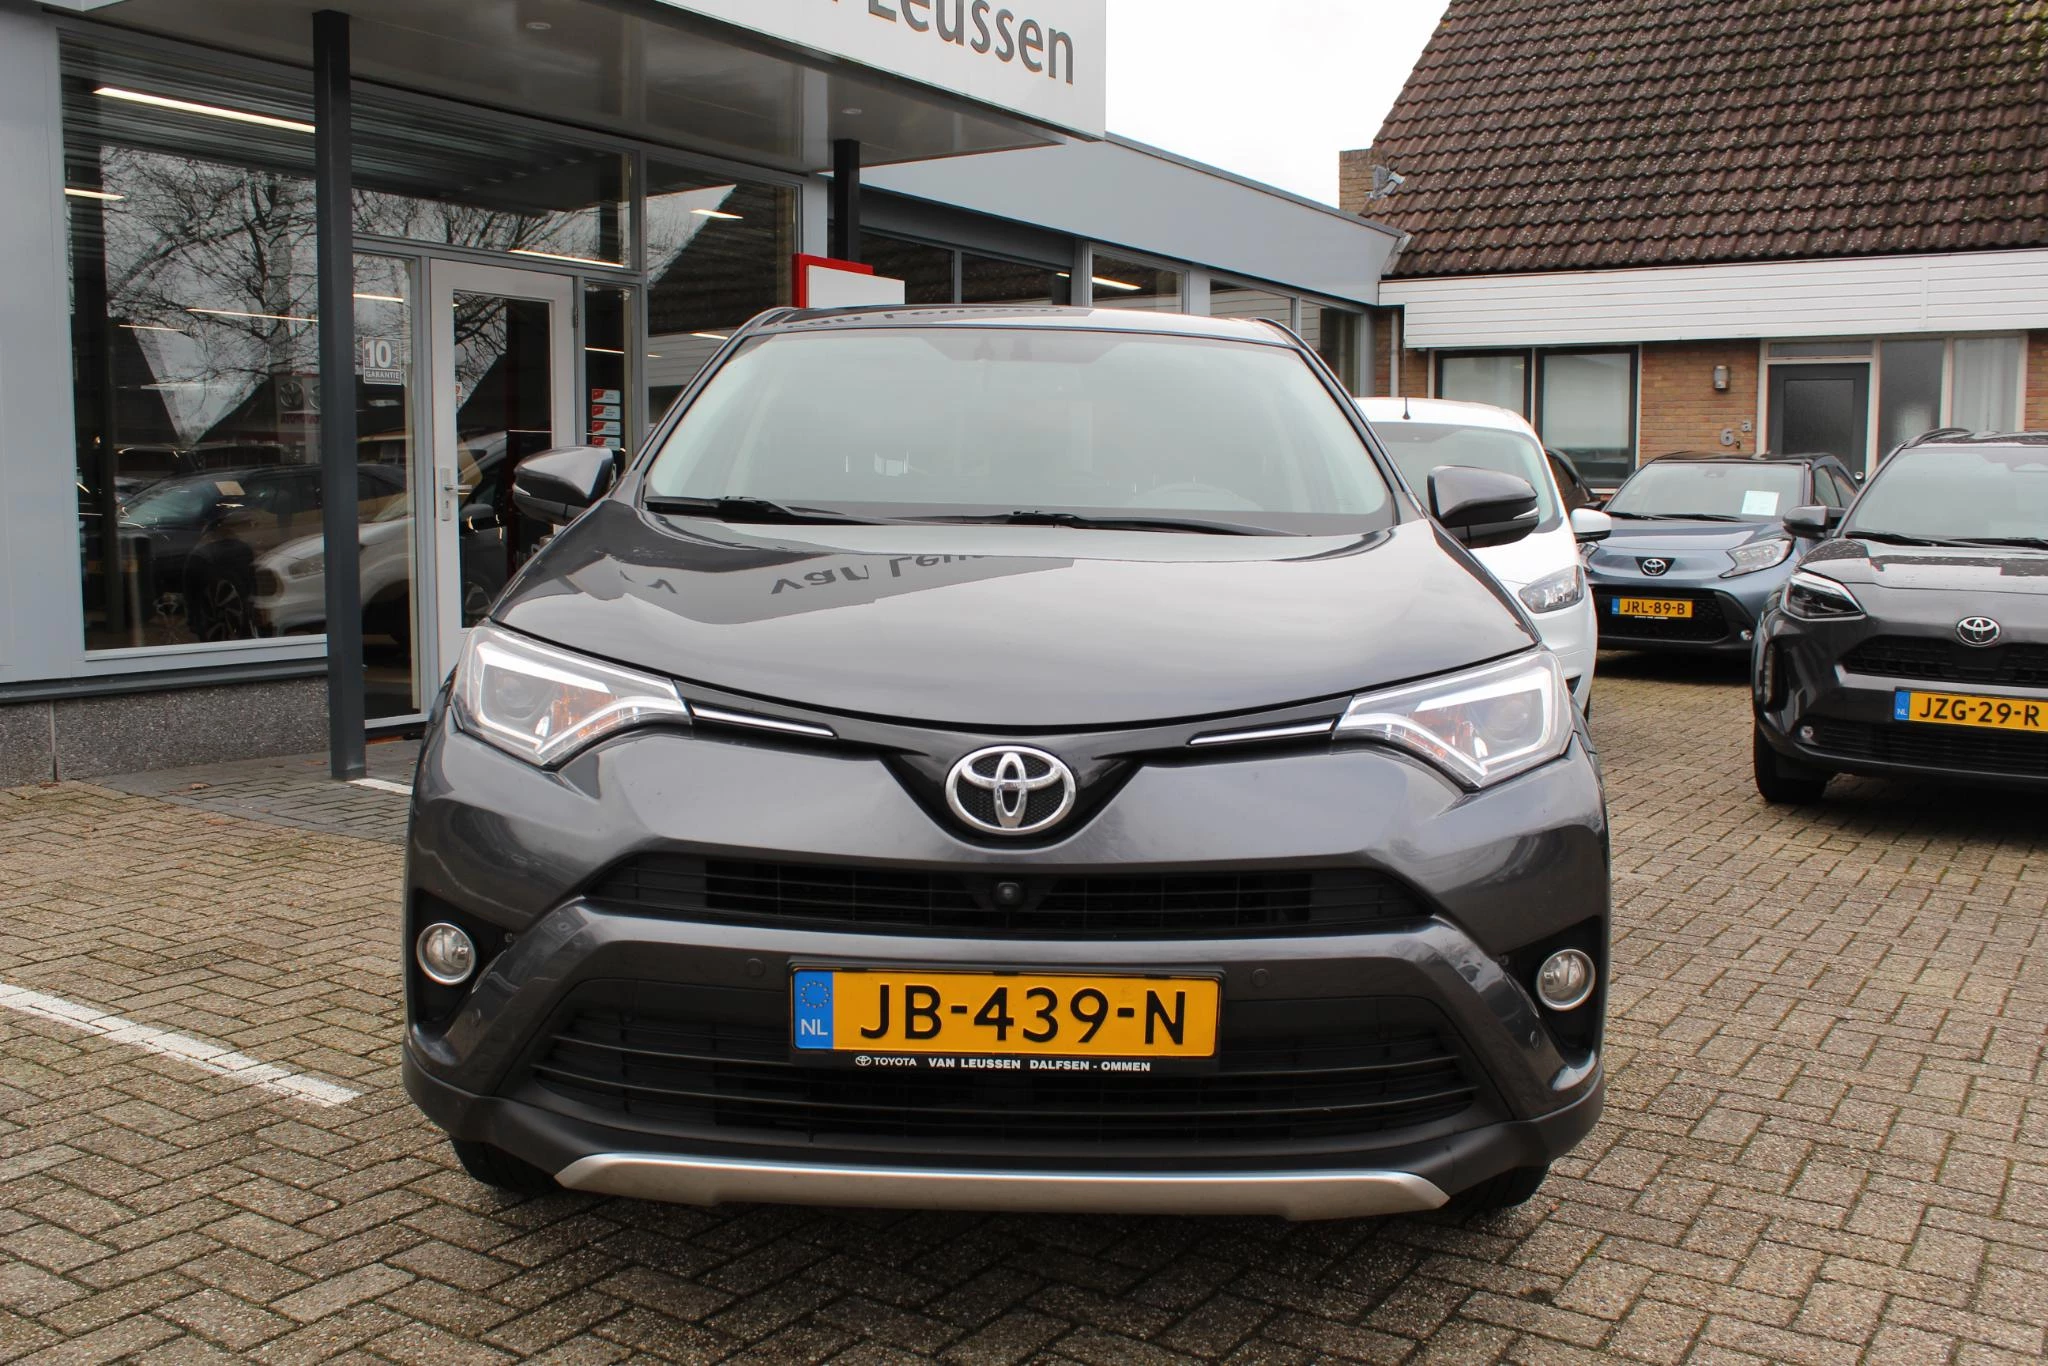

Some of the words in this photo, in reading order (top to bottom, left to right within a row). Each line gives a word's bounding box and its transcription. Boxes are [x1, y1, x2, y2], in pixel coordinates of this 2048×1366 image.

[868, 0, 1074, 85] eussen
[365, 340, 392, 368] 10
[366, 370, 400, 379] GARANTIE
[1720, 428, 1735, 446] 6
[1624, 601, 1685, 615] JRL-89-B
[1919, 697, 2040, 727] JZG-29-R
[801, 1019, 828, 1036] NL
[860, 984, 1186, 1045] JB-439-N
[873, 1056, 917, 1067] TOYOTA
[928, 1058, 955, 1068] VAN
[960, 1058, 1021, 1069] LEUSSEN
[1030, 1059, 1090, 1070] DALFSEN
[1101, 1061, 1151, 1072] OMMEN
